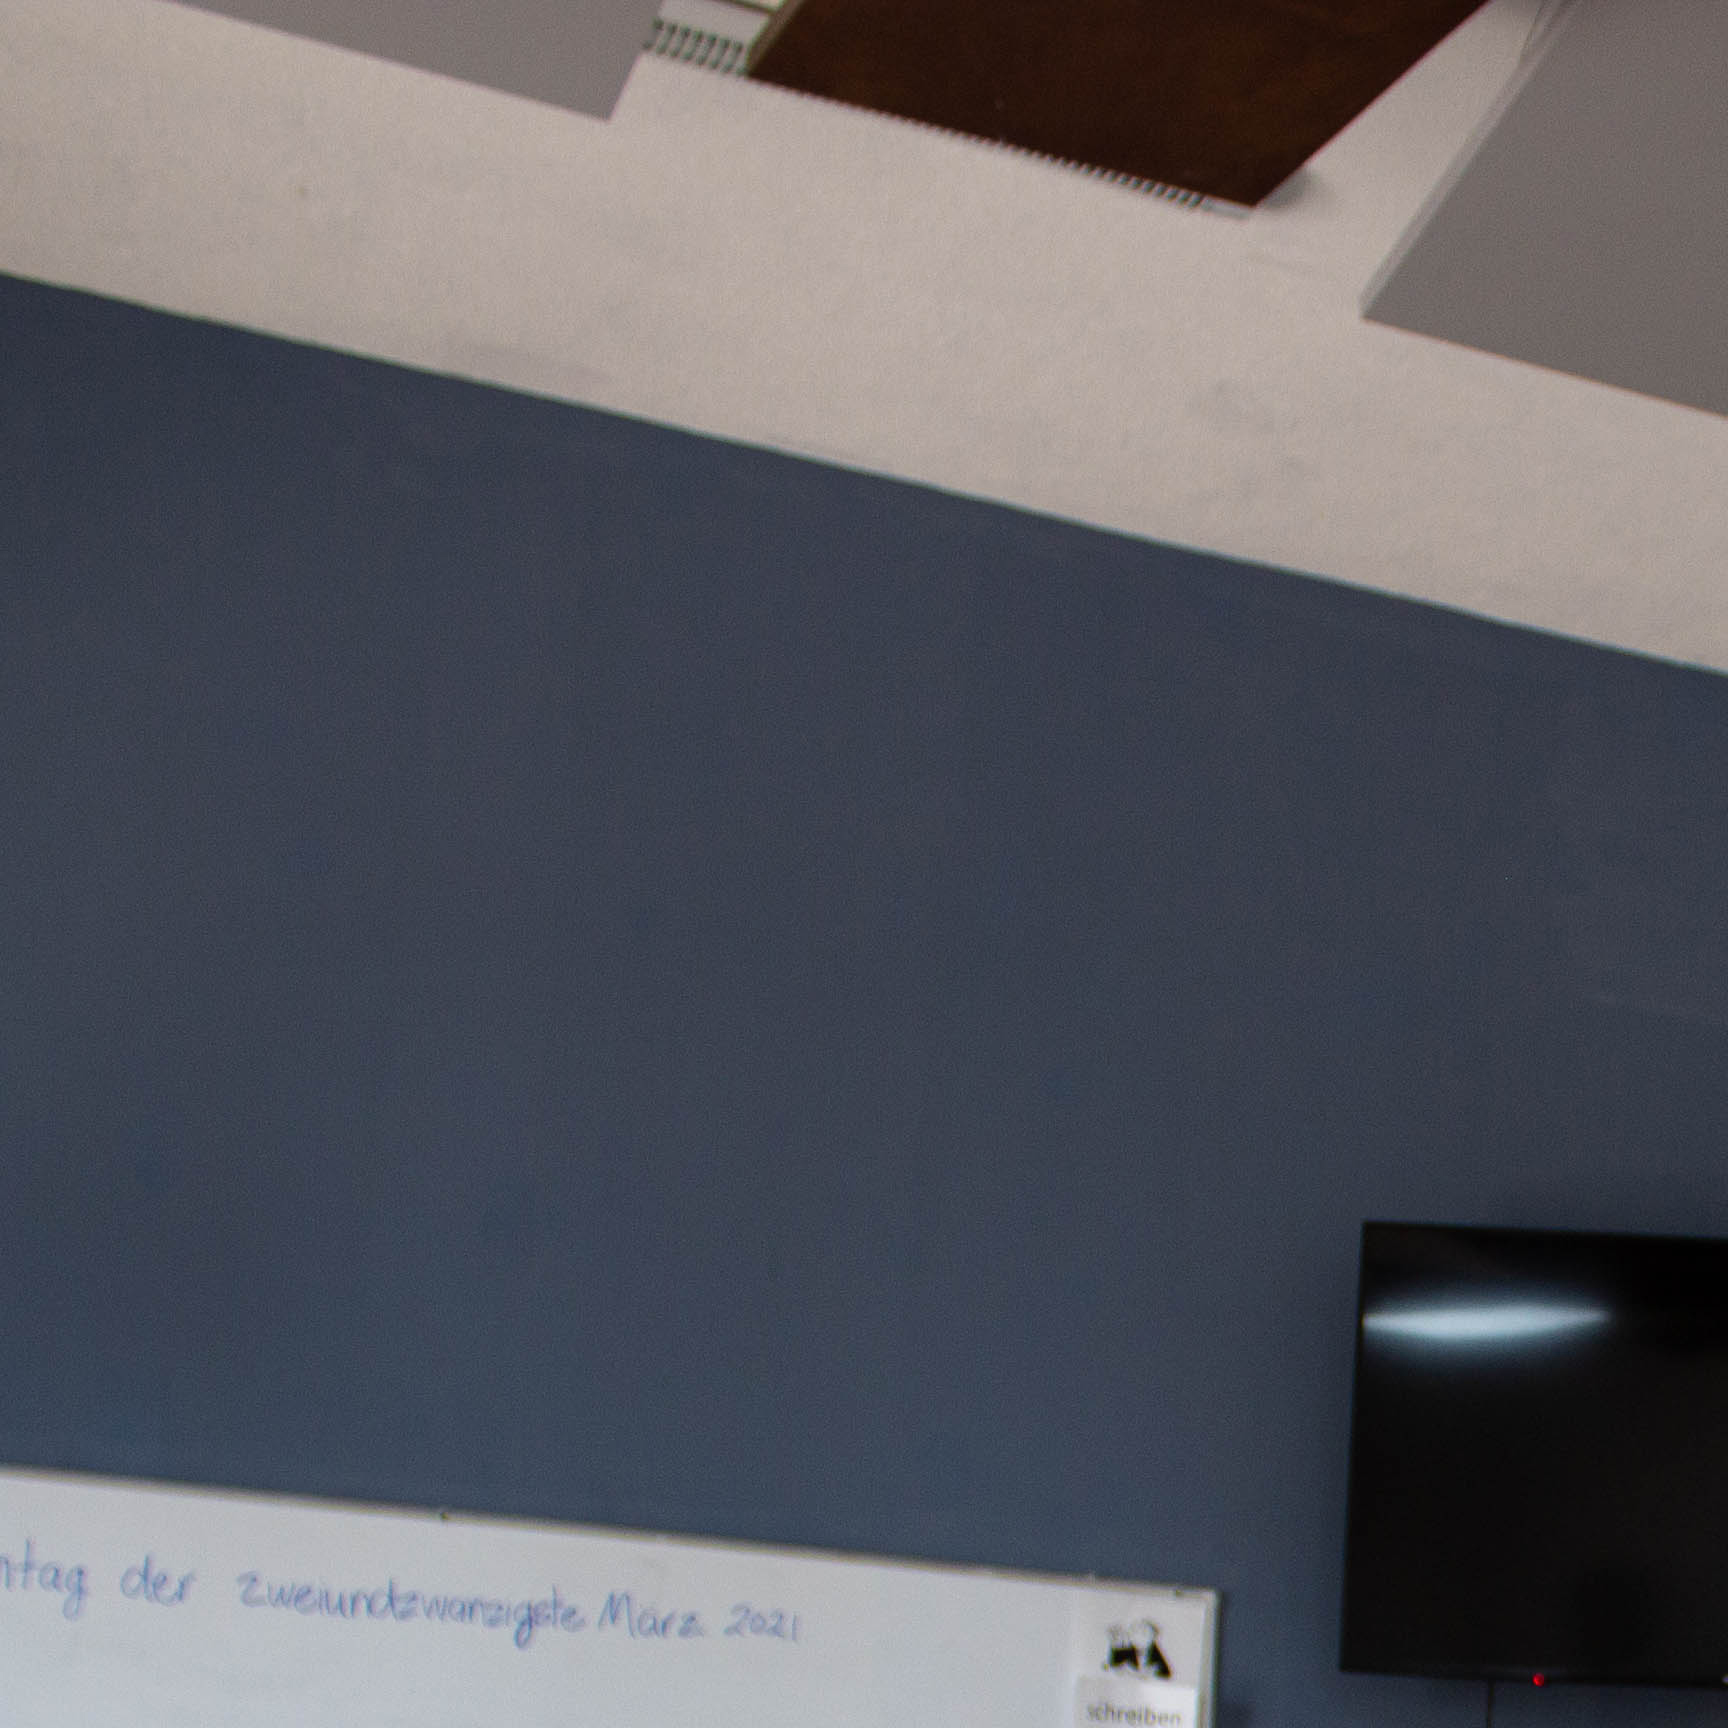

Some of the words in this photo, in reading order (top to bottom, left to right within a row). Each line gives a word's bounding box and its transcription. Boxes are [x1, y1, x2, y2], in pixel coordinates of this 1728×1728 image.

[120, 1553, 196, 1607] der
[724, 1599, 799, 1641] 2021
[1086, 1703, 1183, 1728] schreiben
